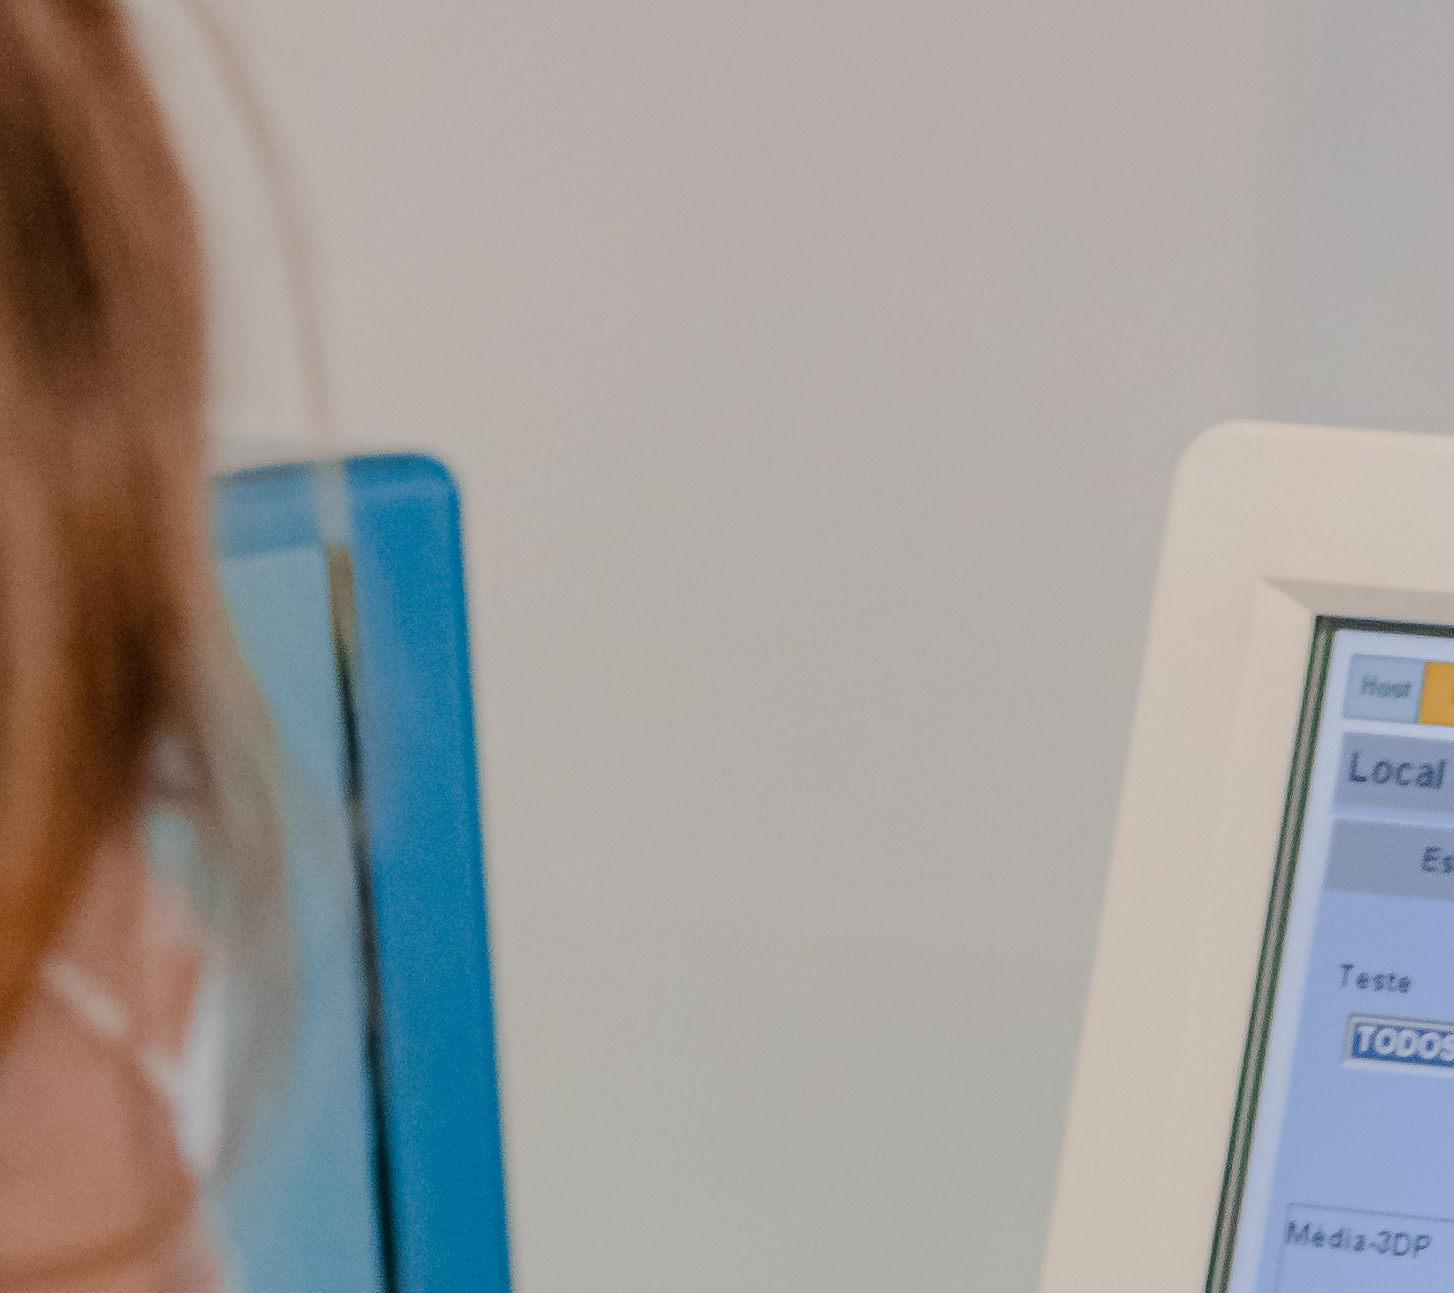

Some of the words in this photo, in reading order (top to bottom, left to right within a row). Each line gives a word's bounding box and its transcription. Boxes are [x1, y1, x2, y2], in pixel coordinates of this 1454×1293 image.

[1348, 748, 1444, 790] Local
[1337, 962, 1414, 995] Teste
[1284, 1219, 1433, 1259] Média-3DP
